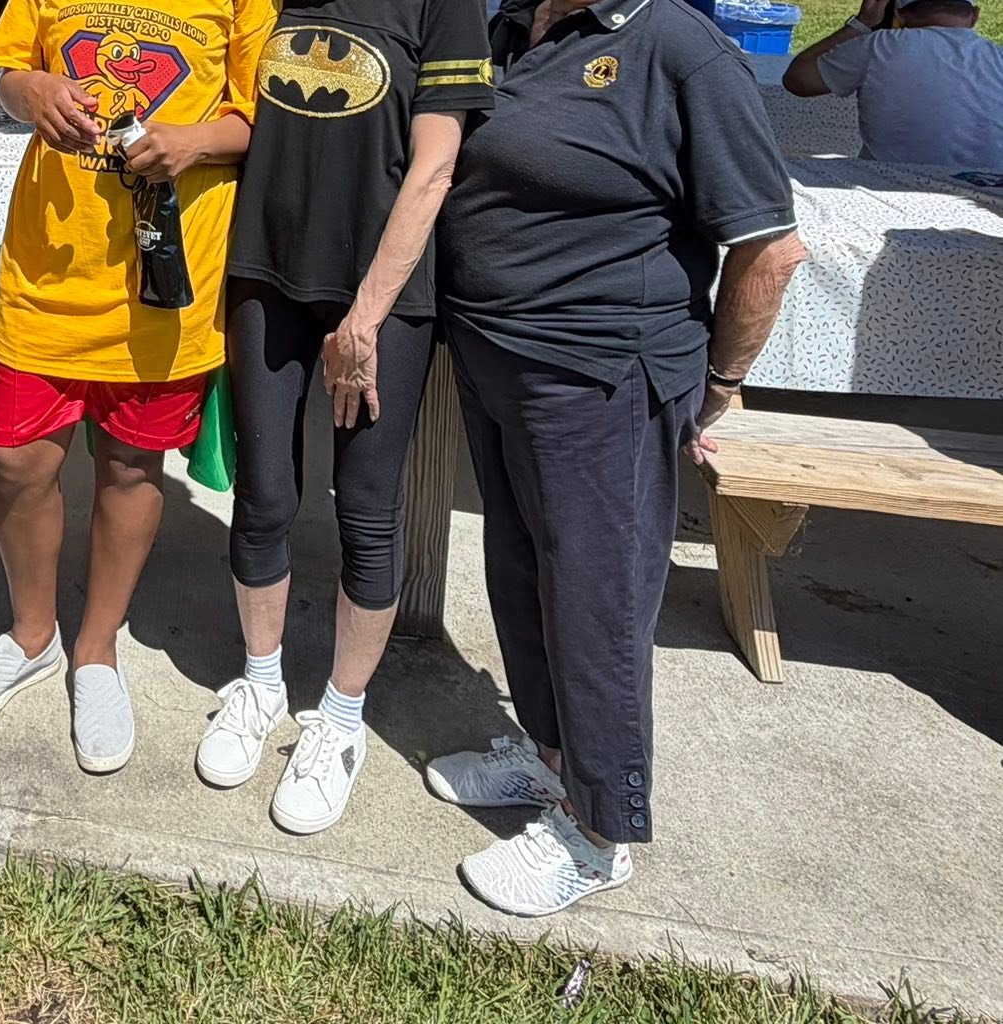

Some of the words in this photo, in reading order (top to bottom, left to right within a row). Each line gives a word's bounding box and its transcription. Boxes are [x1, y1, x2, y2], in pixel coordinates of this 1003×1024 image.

[58, 3, 96, 21] HUDSON
[97, 3, 133, 15] VALLEY
[134, 6, 181, 31] CATSKILLS
[181, 22, 208, 46] LIONS
[86, 15, 141, 33] DISTRICT
[80, 154, 121, 172] WAL
